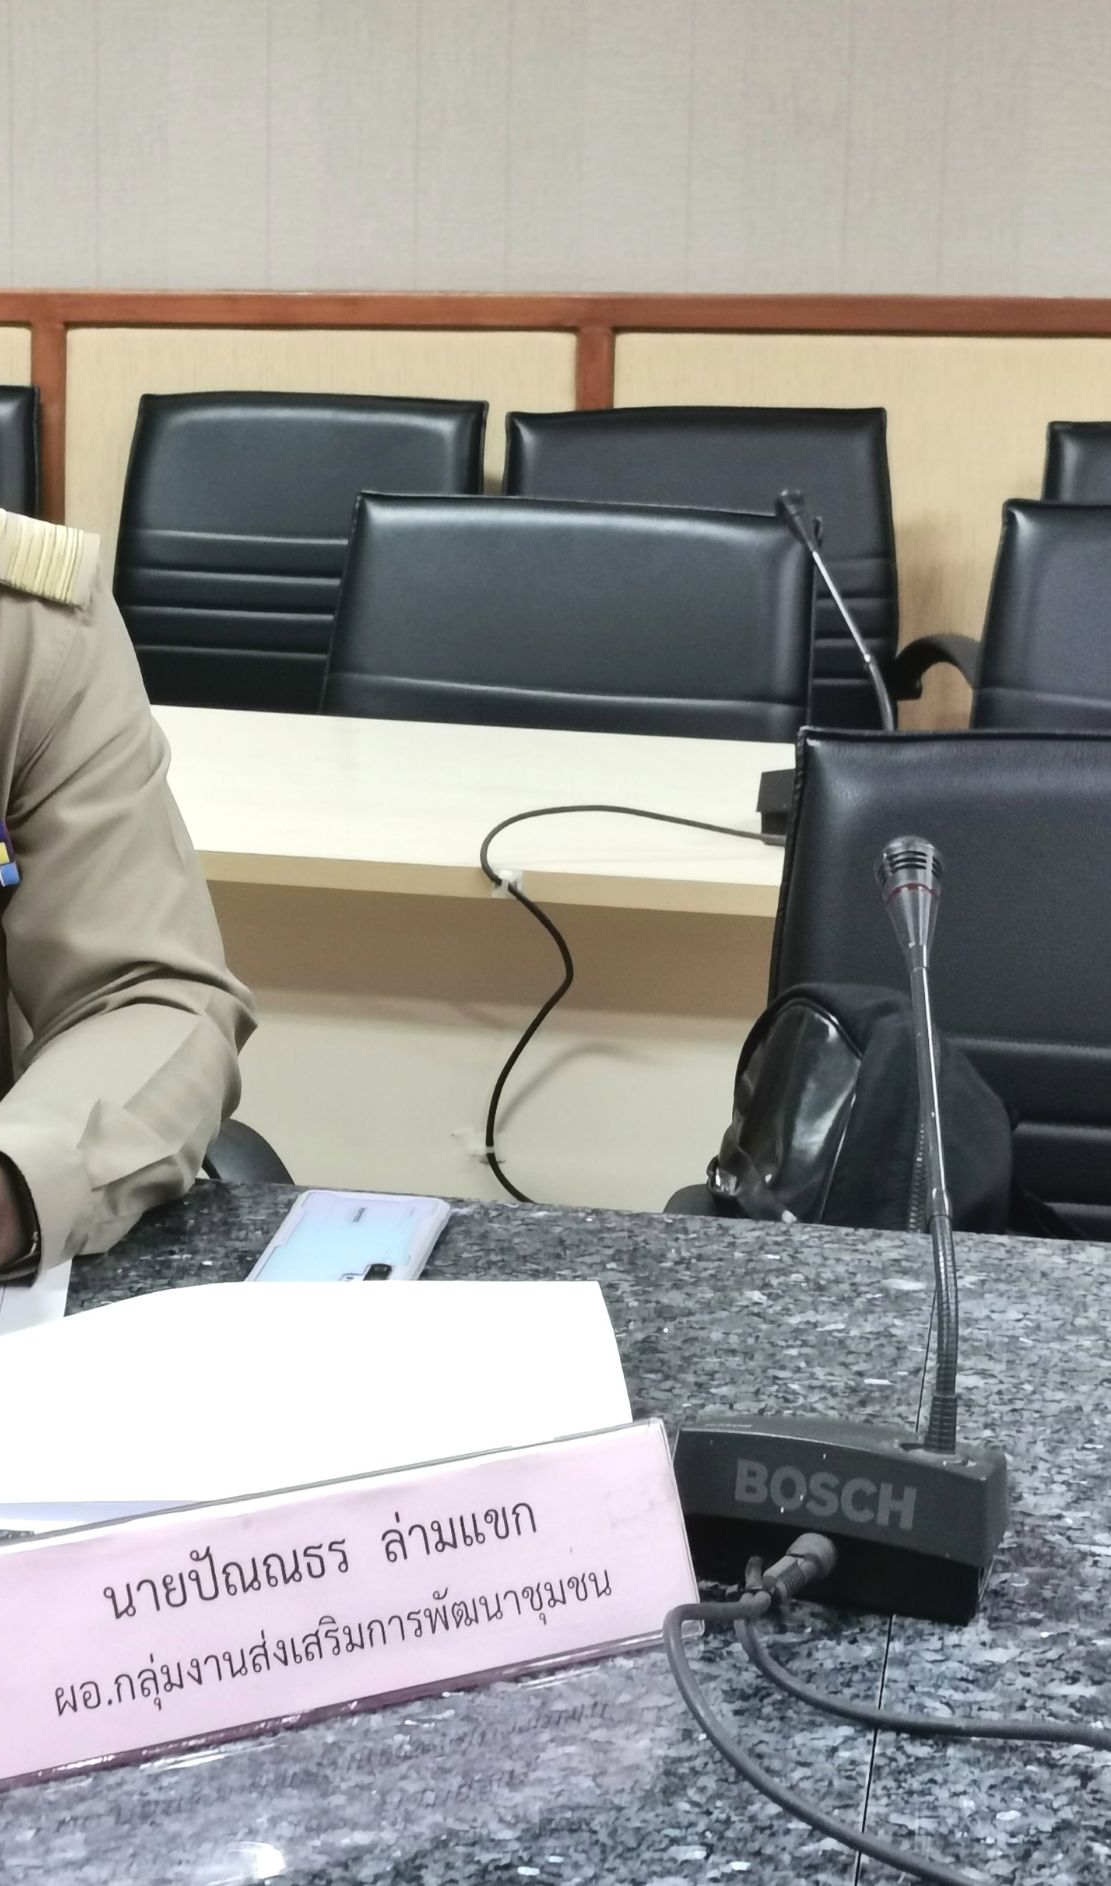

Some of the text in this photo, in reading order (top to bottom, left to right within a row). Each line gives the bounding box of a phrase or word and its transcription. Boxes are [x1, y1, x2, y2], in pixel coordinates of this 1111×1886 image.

[734, 1460, 917, 1530] BOSCH
[103, 1500, 538, 1620] นายปัณณธร ล่ามแขก
[54, 1568, 612, 1717] ผอ.กลุ่มงานส่งเสริมการพัฒนาชุมชน
